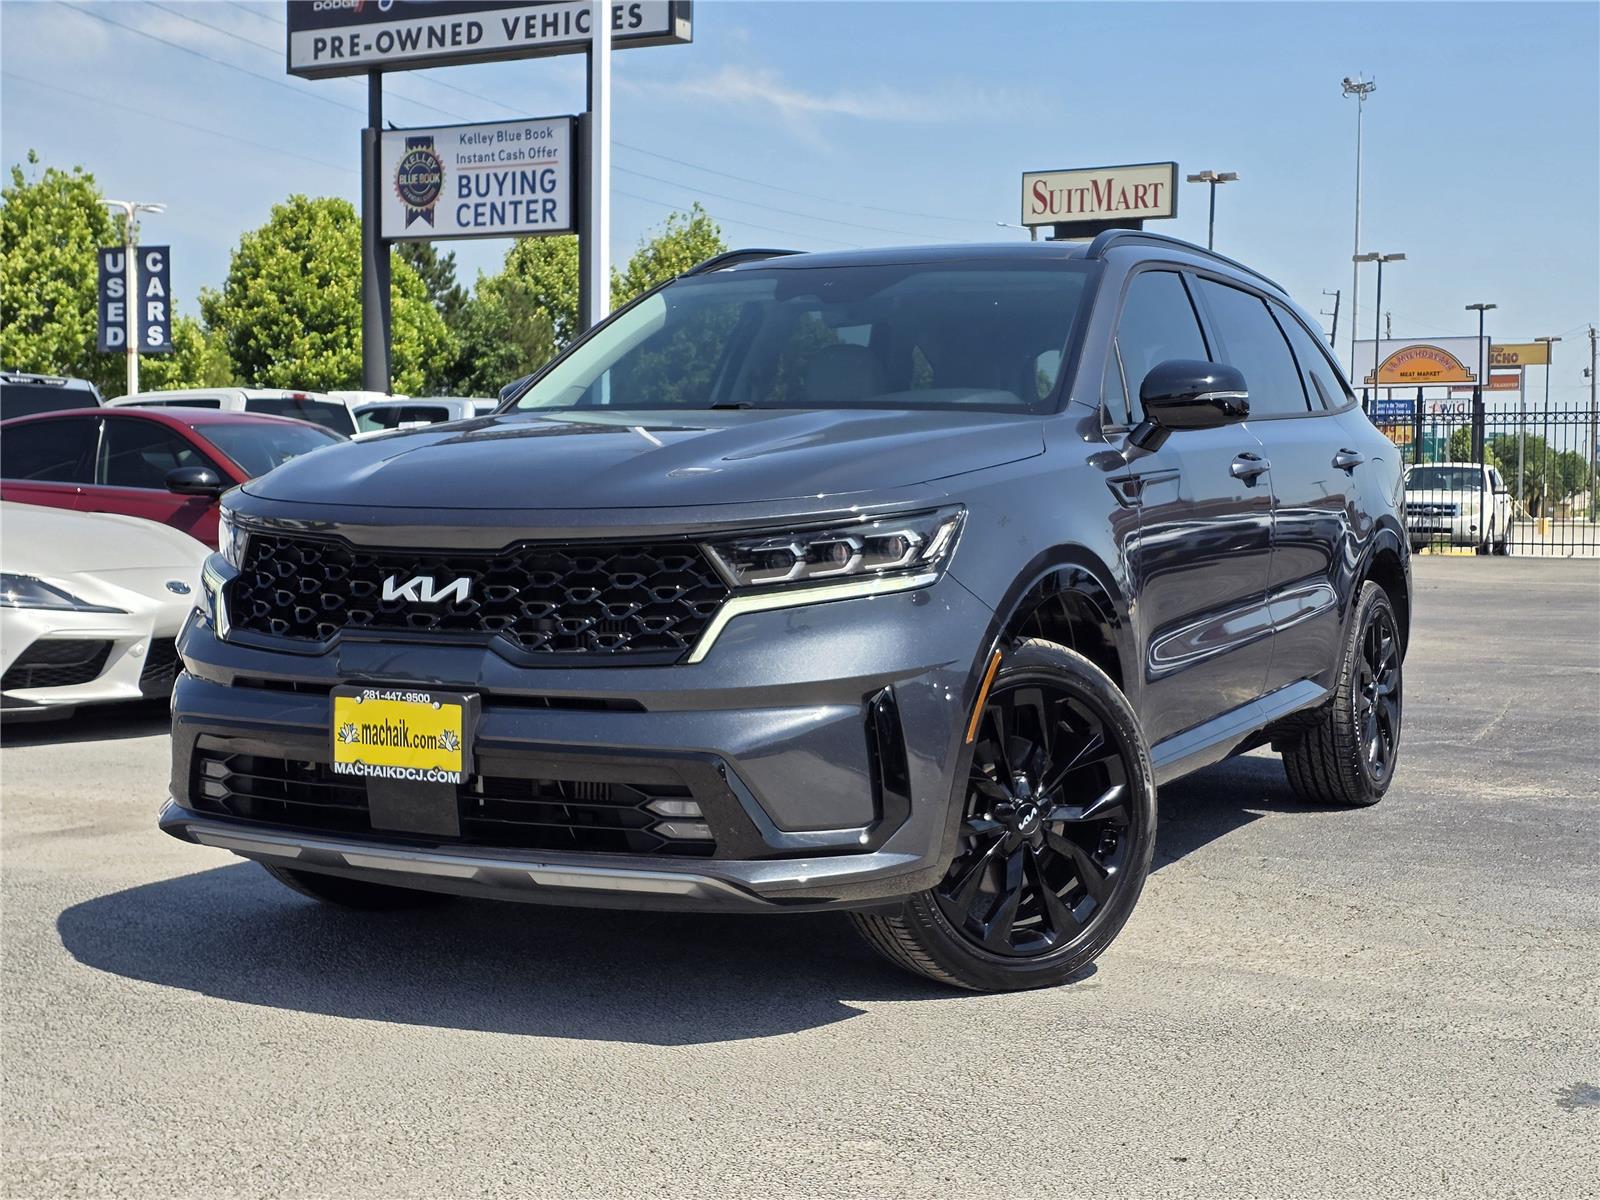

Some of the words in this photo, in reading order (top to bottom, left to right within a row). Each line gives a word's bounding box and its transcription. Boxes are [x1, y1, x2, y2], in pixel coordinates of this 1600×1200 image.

[313, 21, 483, 60] PRE-OWNED
[502, 3, 643, 41] VEHICES
[460, 132, 494, 146] Kelley
[497, 130, 521, 142] Blue
[525, 126, 553, 140] Book
[404, 153, 437, 171] KELLEY
[456, 152, 495, 164] Instant
[498, 149, 525, 161] Cash
[528, 146, 558, 159] Offer
[399, 173, 418, 185] BLUE
[419, 172, 440, 184] BOOK
[458, 168, 557, 199] BUYING
[456, 198, 557, 228] CENTER
[105, 253, 125, 346] USED
[146, 252, 165, 346] CARS
[363, 690, 430, 704] 281-447-9500
[361, 718, 437, 750] machaik.com
[334, 763, 460, 784] MACHAIKDCJ.COM
